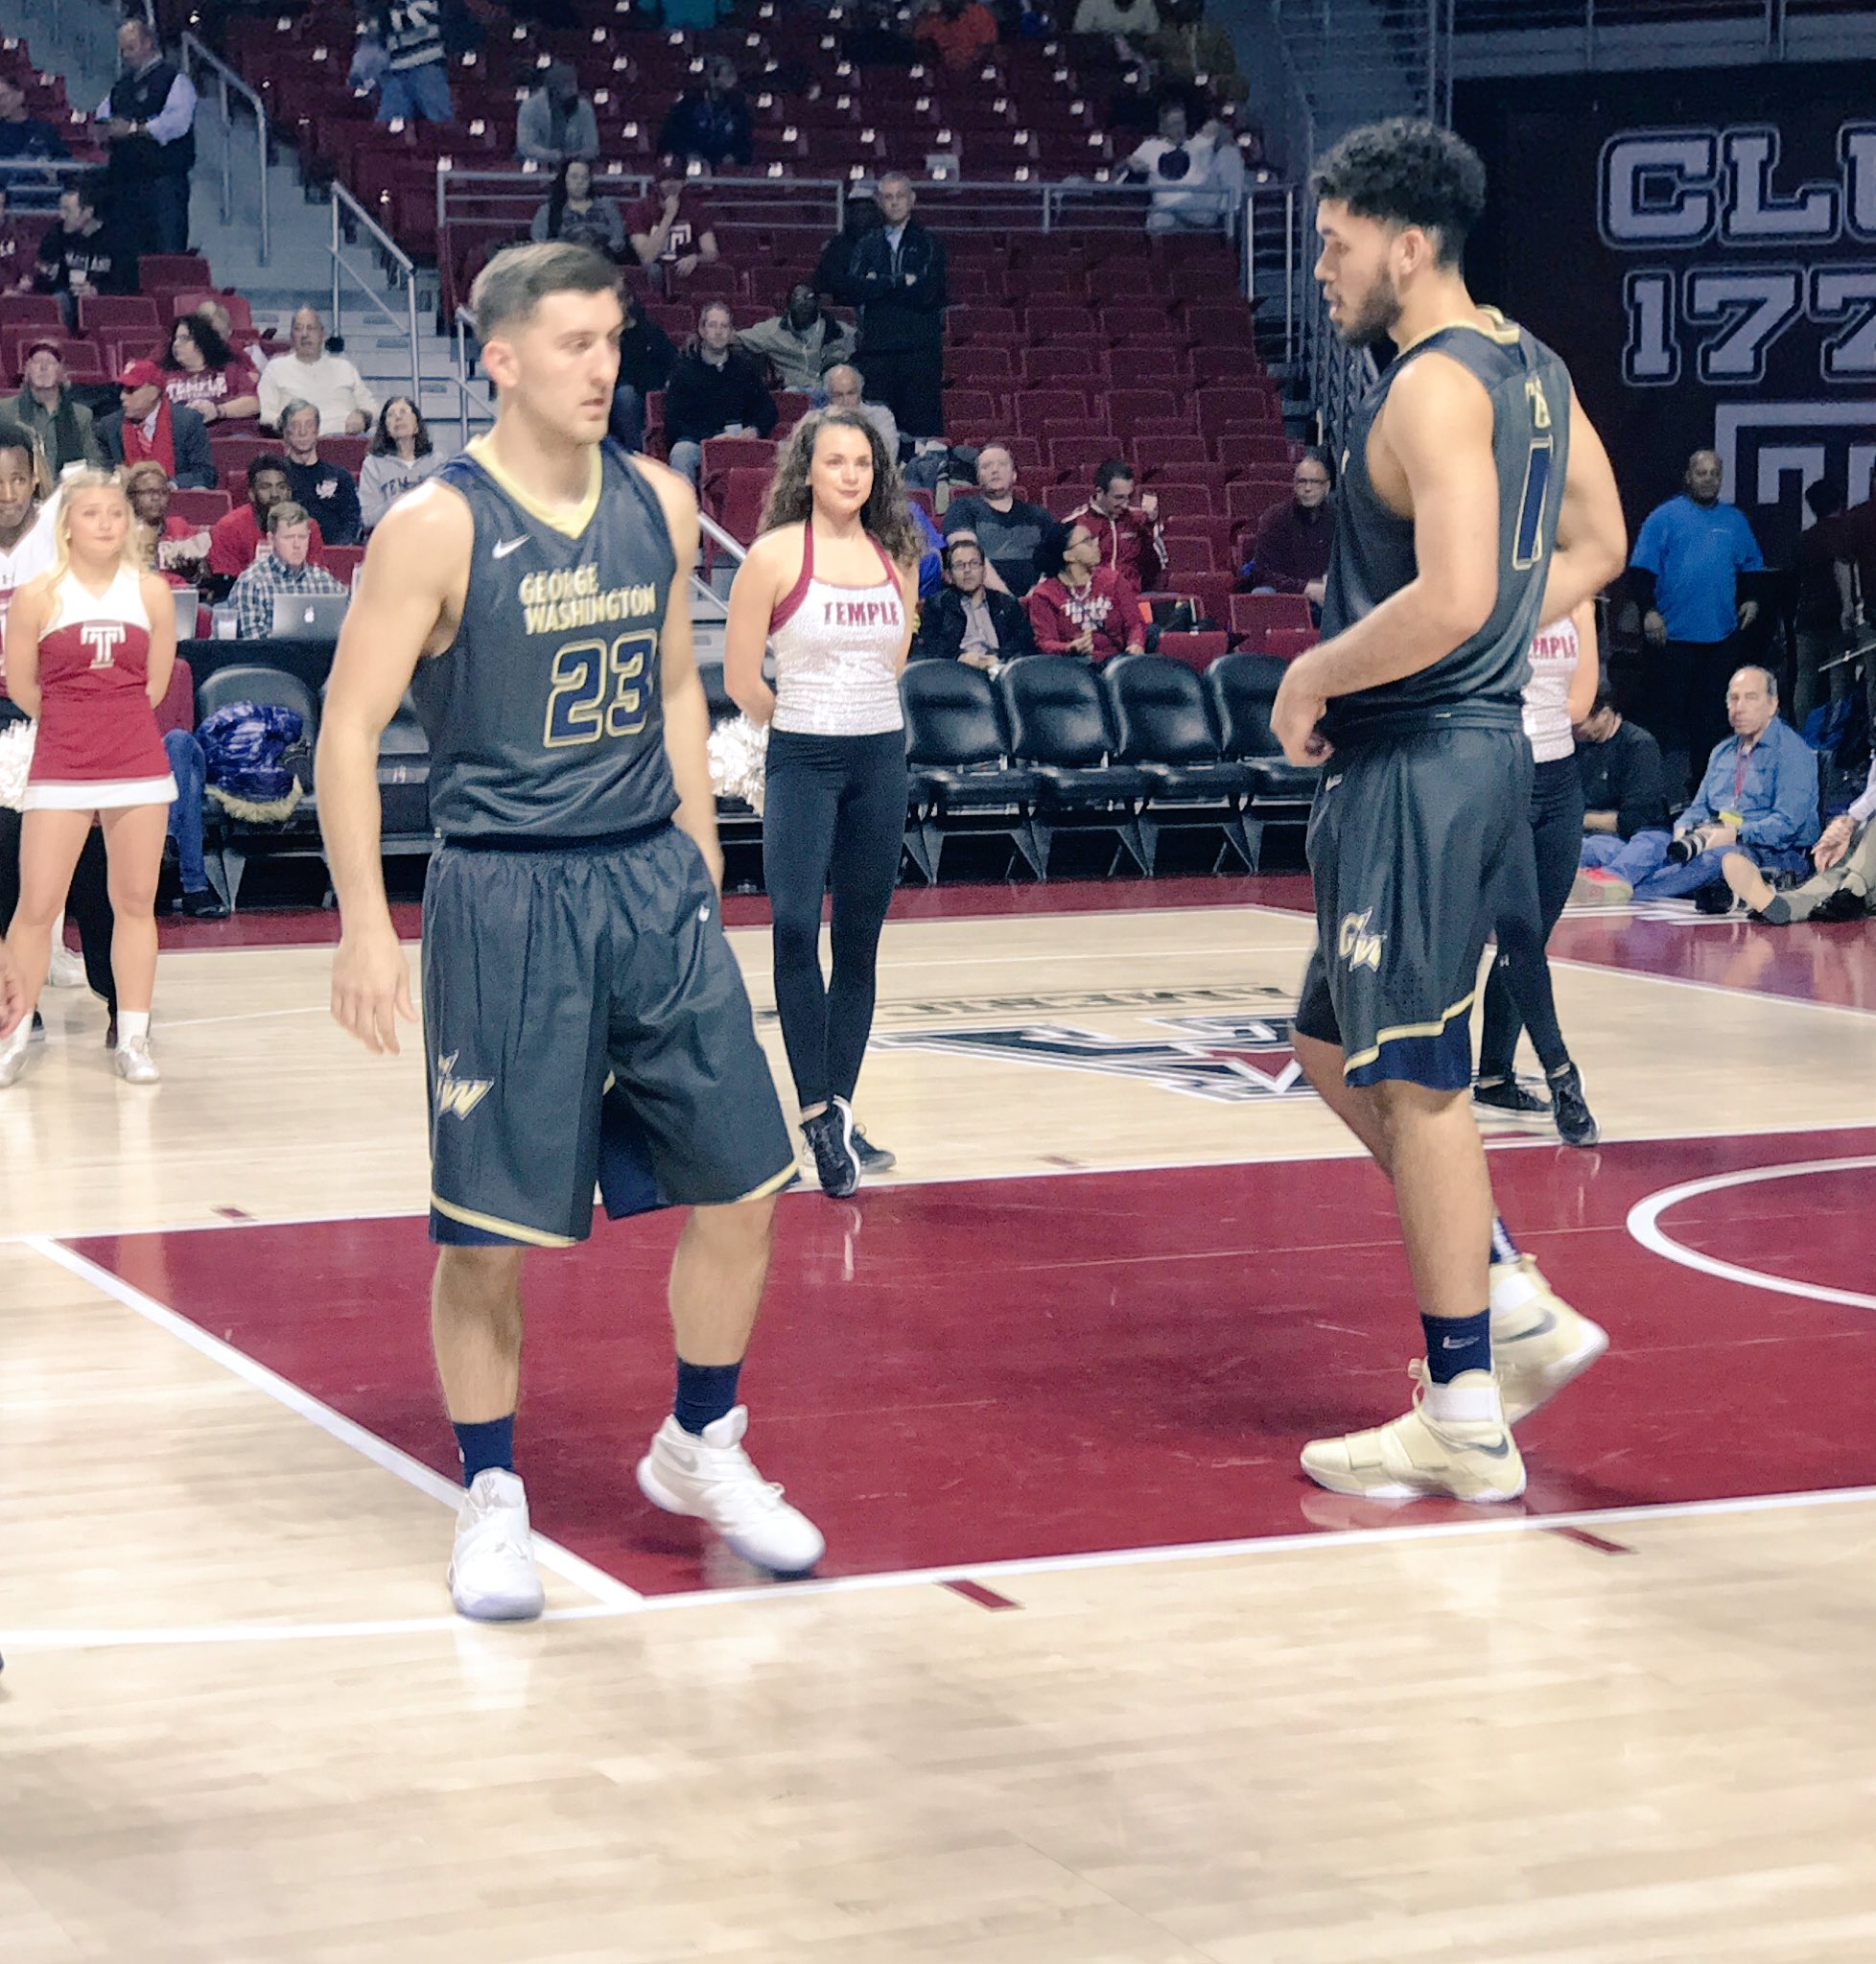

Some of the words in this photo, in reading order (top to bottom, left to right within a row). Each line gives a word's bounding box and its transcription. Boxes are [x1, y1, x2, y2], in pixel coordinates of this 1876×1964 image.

[519, 562, 599, 605] GEORGE
[524, 581, 656, 635] WASHINGTON
[824, 600, 900, 626] TEMPLE
[81, 620, 126, 669] T
[543, 628, 658, 748] 23
